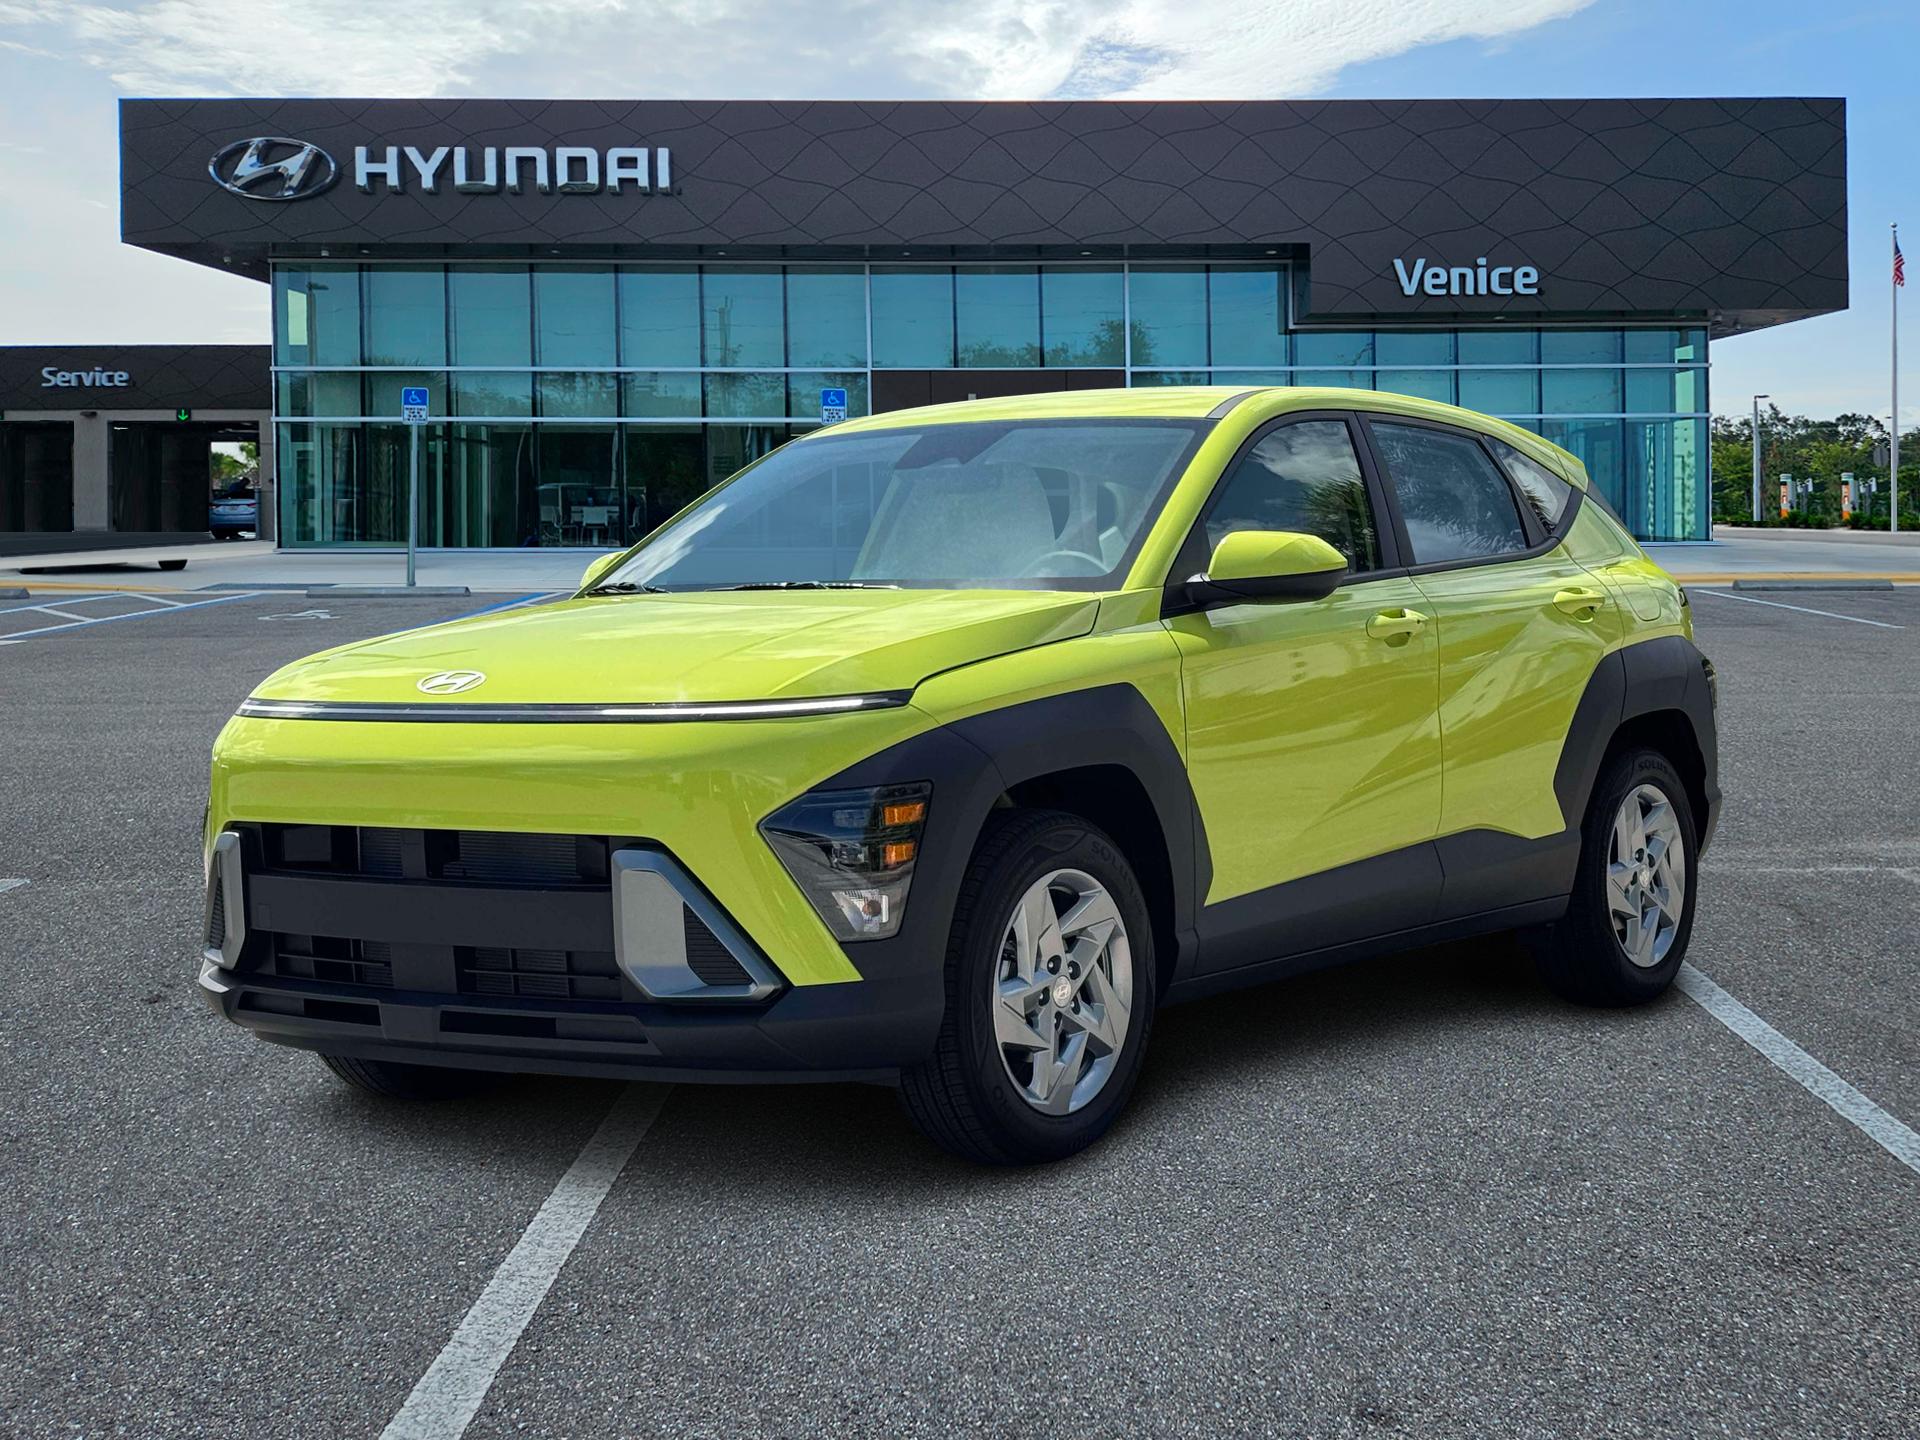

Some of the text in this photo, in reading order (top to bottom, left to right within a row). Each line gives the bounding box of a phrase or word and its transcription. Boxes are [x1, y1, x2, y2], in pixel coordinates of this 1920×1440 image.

[353, 145, 674, 195] HYUNDAI
[1392, 256, 1540, 297] Venice
[40, 366, 130, 388] Service
